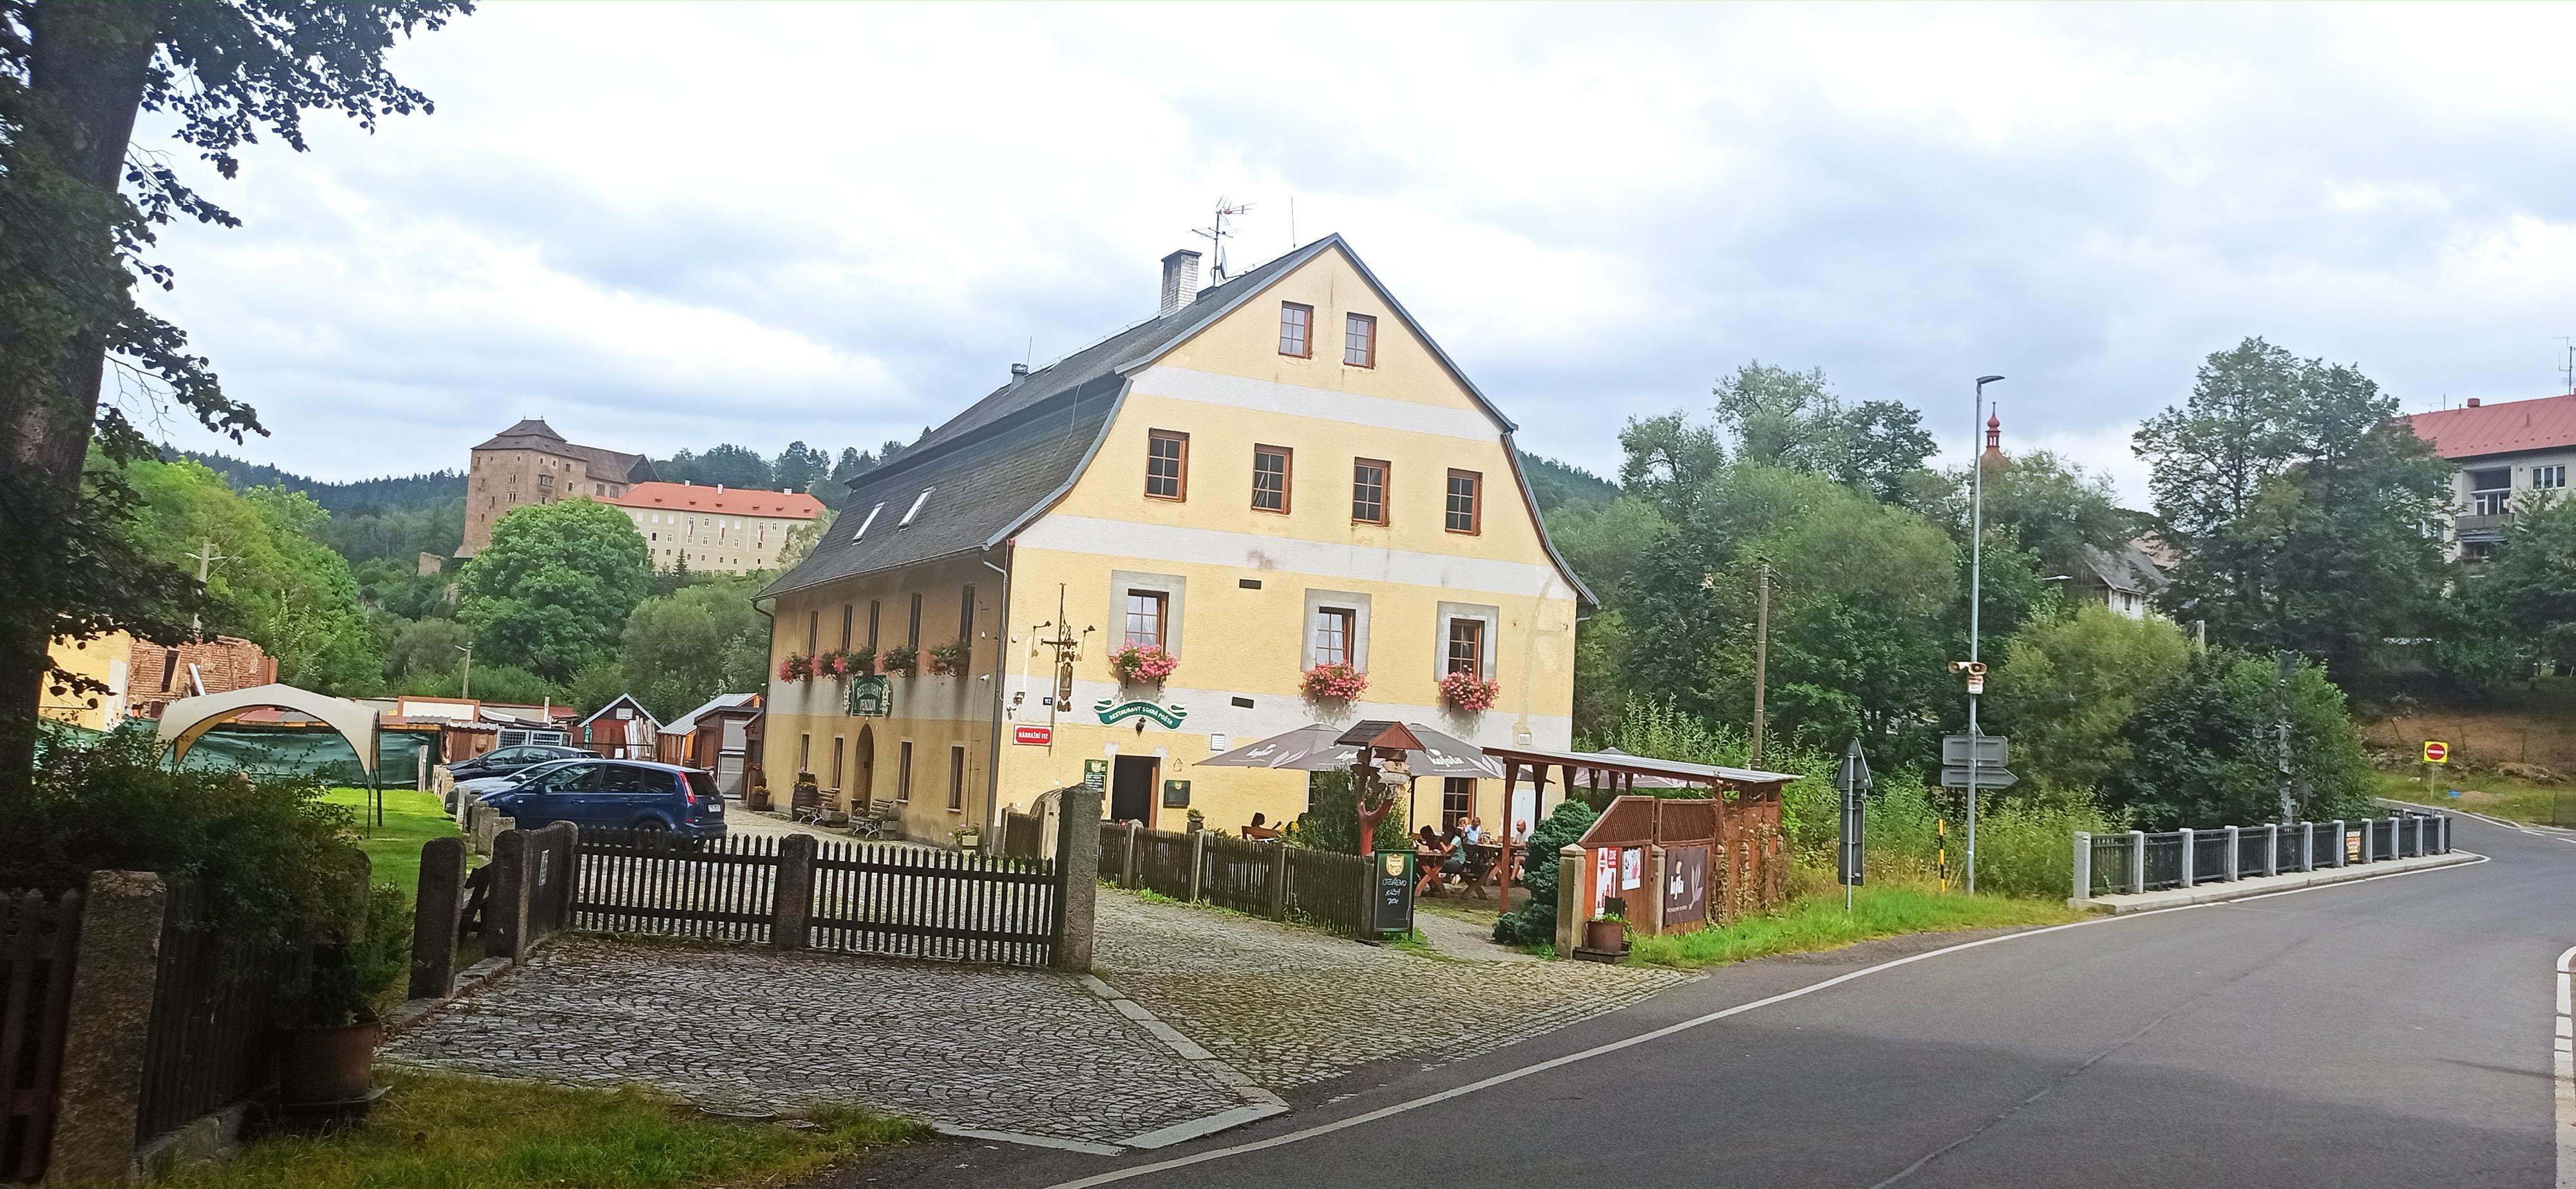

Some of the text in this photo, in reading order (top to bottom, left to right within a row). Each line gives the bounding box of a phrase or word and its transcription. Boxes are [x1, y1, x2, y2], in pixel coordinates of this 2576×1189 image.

[1108, 706, 1173, 726] RESTAURANT STARÁ POŠTA
[1426, 754, 1465, 767] kofola
